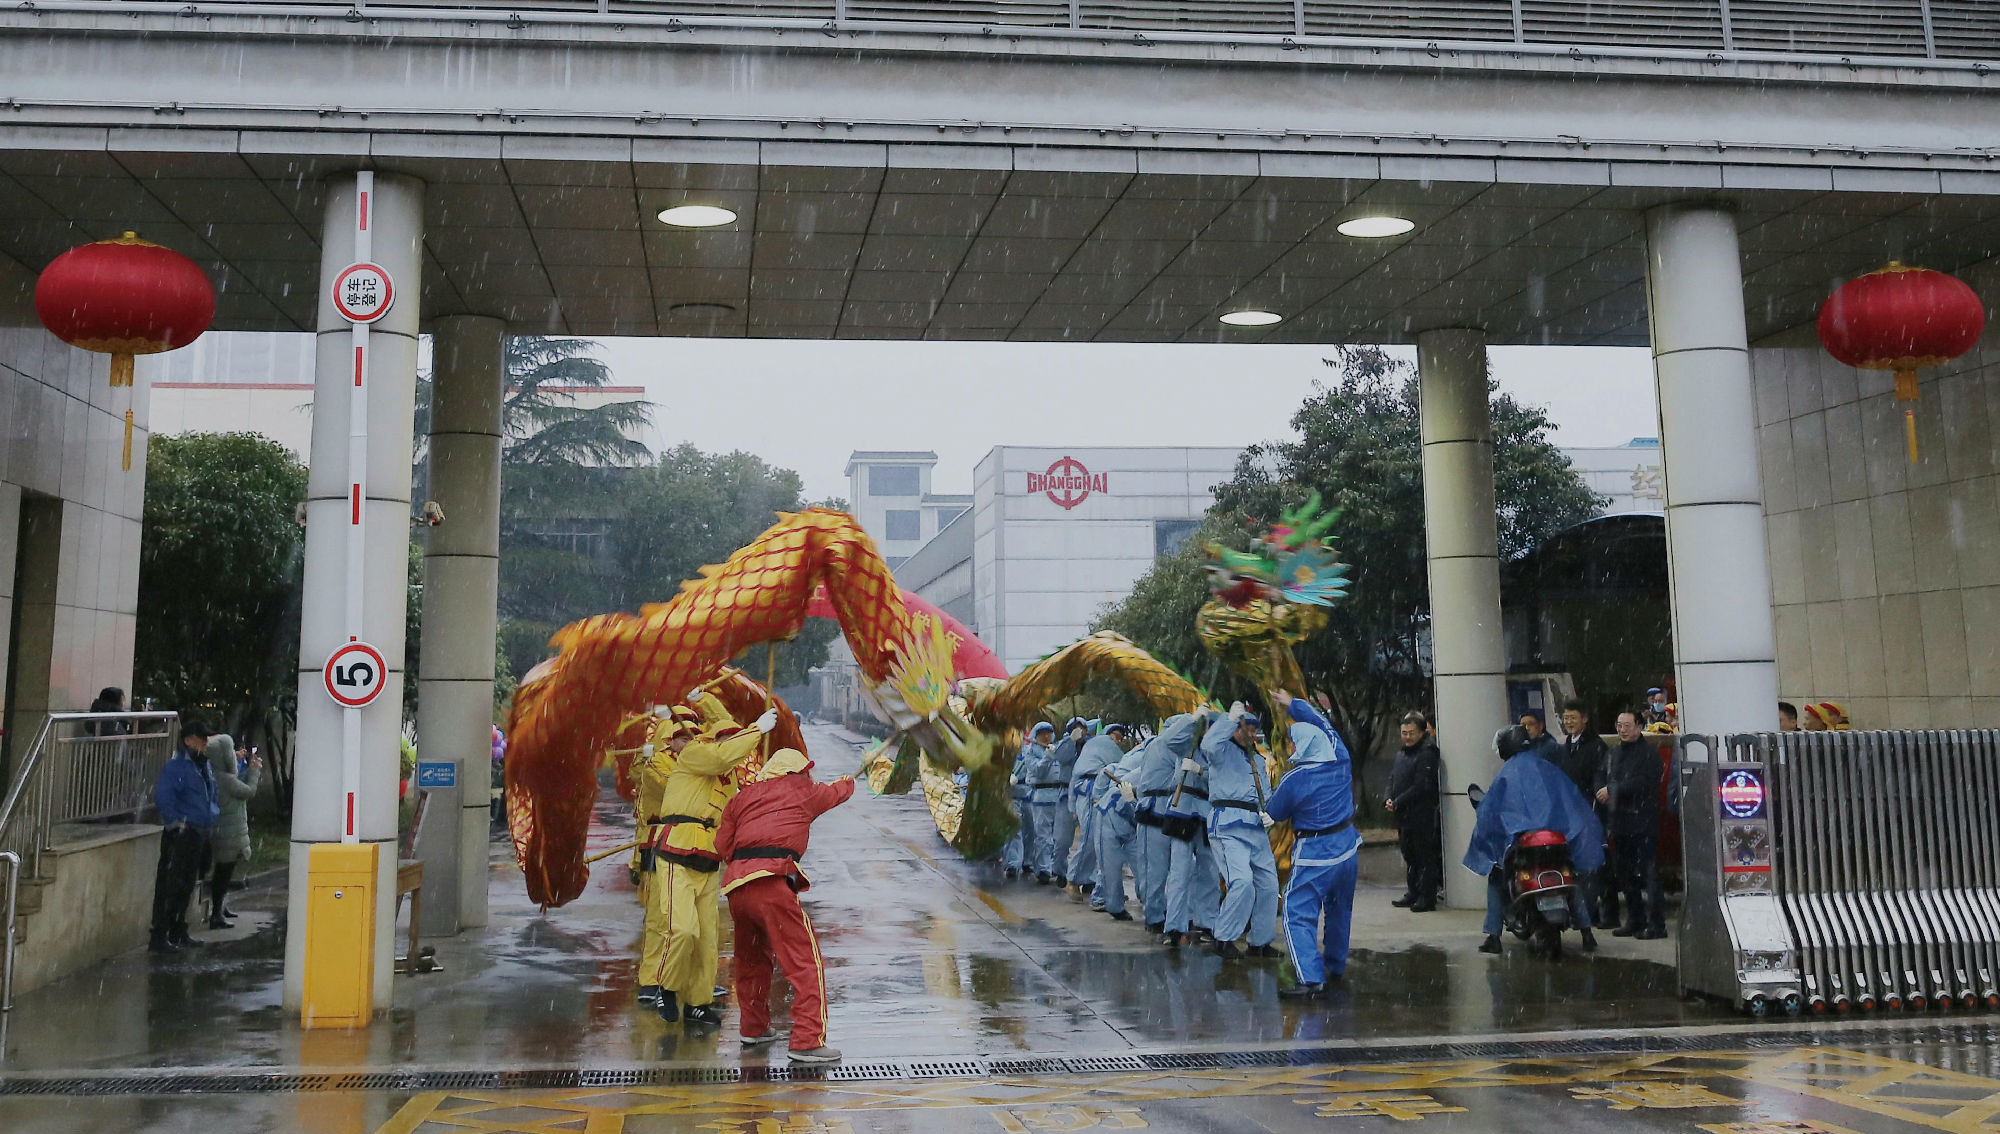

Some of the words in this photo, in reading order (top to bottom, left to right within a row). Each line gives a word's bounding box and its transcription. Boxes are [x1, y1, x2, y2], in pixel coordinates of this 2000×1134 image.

[346, 278, 361, 306] 停车
[362, 278, 377, 306] 登记
[336, 662, 374, 687] 5
